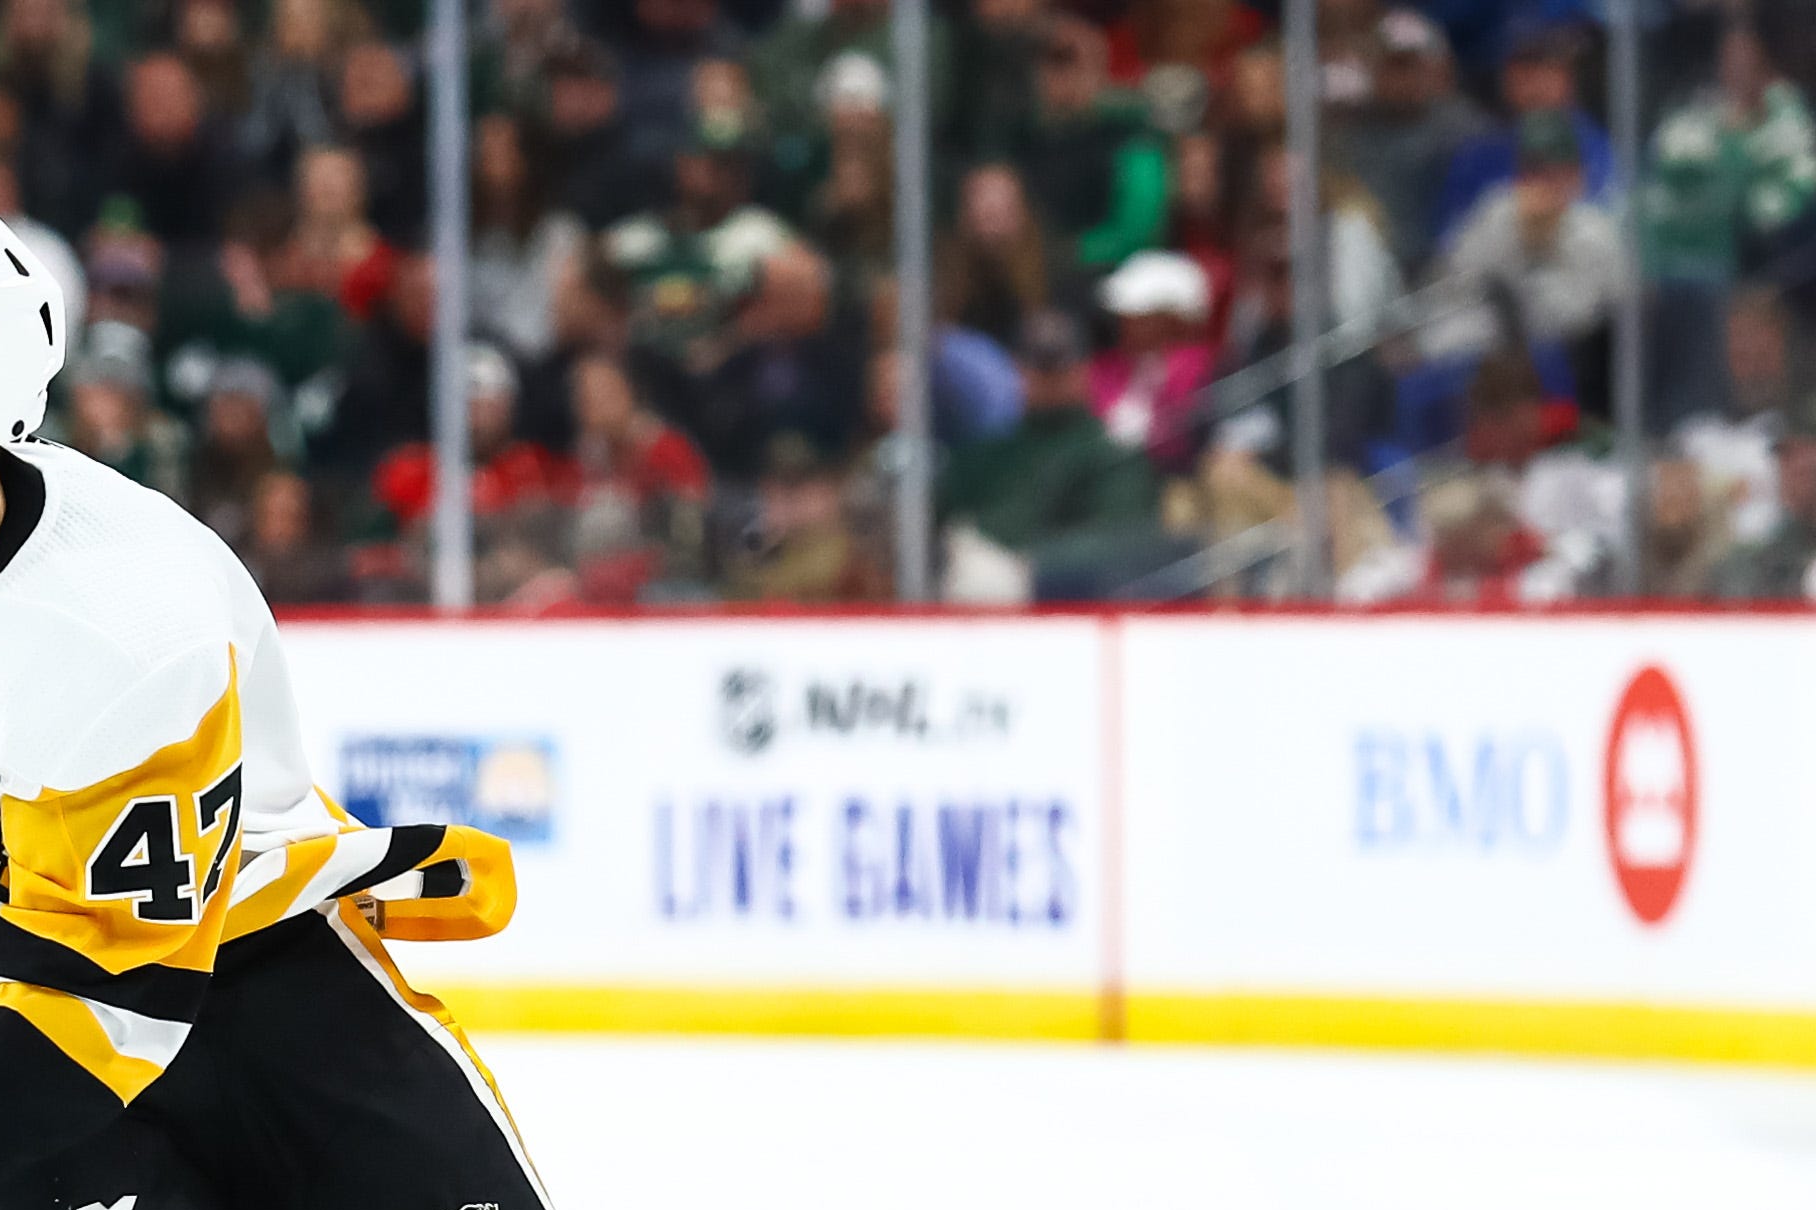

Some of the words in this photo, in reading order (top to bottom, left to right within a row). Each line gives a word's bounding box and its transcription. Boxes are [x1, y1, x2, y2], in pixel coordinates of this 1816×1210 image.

[85, 759, 244, 927] 47
[656, 793, 800, 922] LIVE
[839, 796, 1074, 928] GAMES
[1350, 728, 1572, 858] BMO
